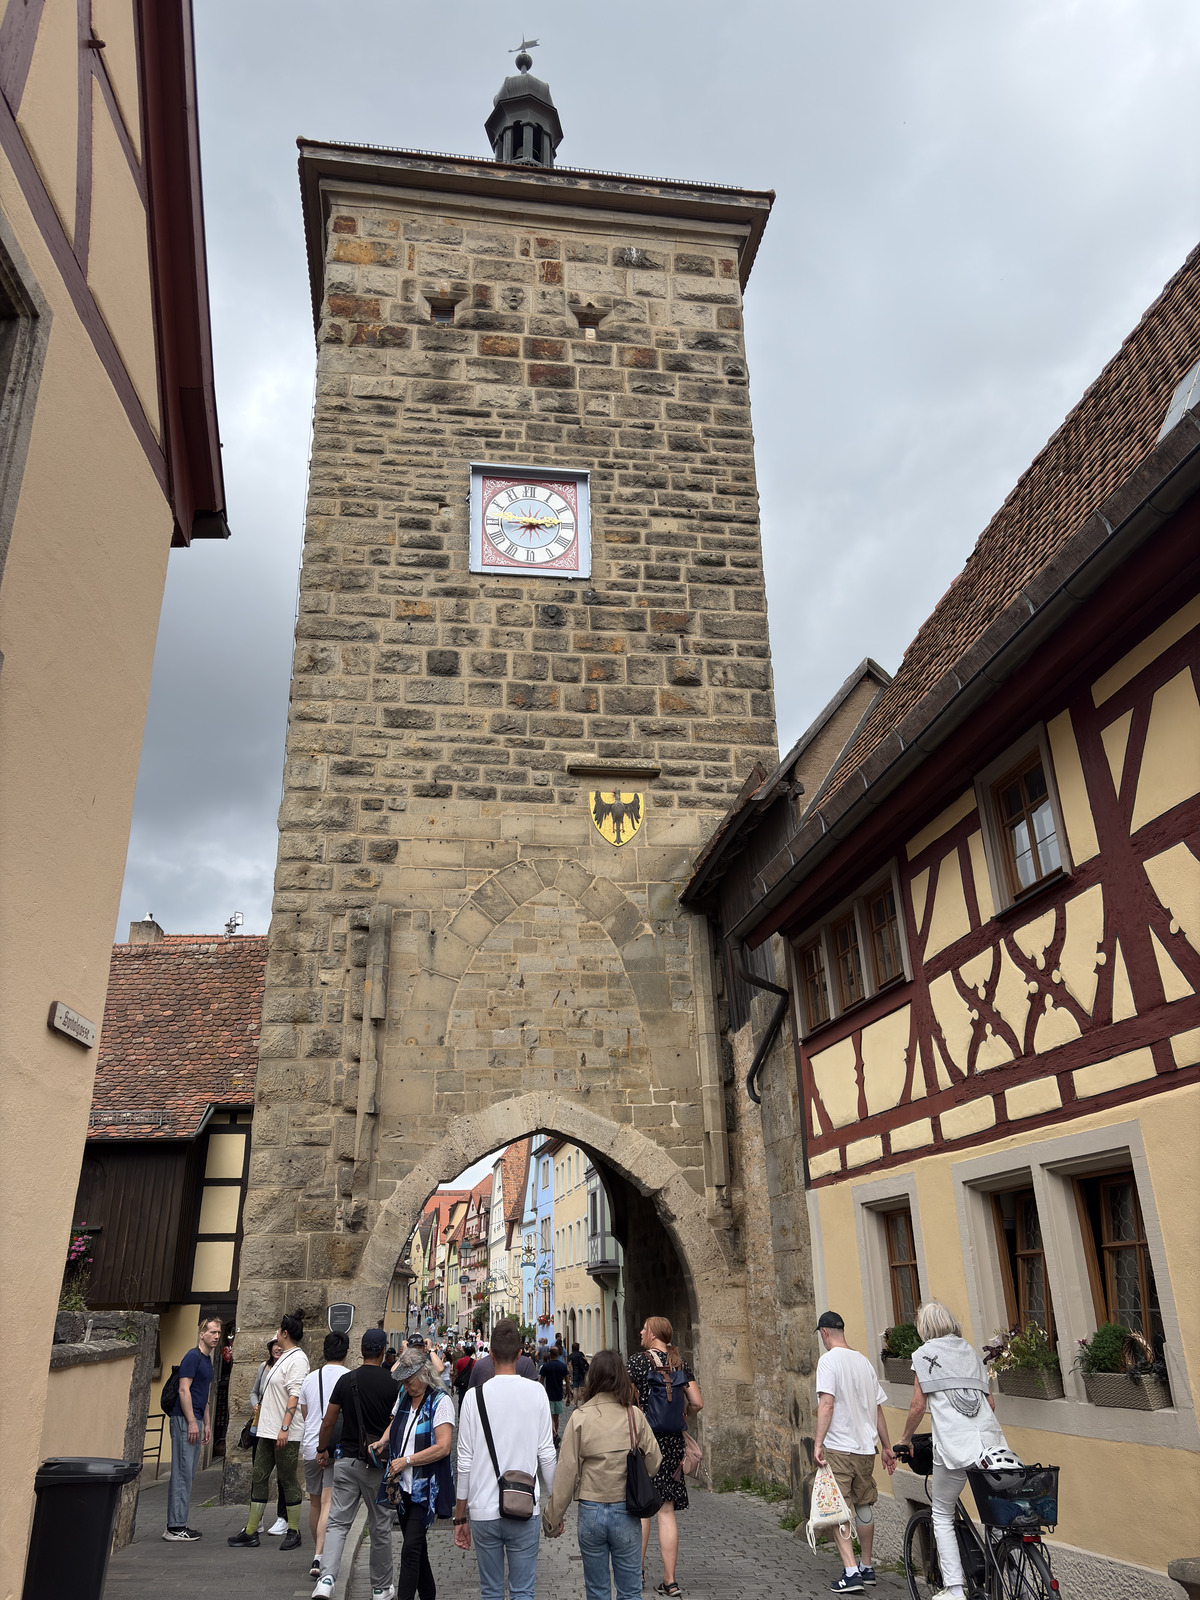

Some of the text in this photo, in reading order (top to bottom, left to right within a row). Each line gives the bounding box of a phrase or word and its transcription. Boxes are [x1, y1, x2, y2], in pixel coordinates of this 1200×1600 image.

[505, 489, 518, 501] XI
[522, 486, 537, 498] XII
[544, 492, 554, 503] I
[556, 505, 570, 515] II
[525, 550, 536, 562] VI
[545, 547, 556, 559] V
